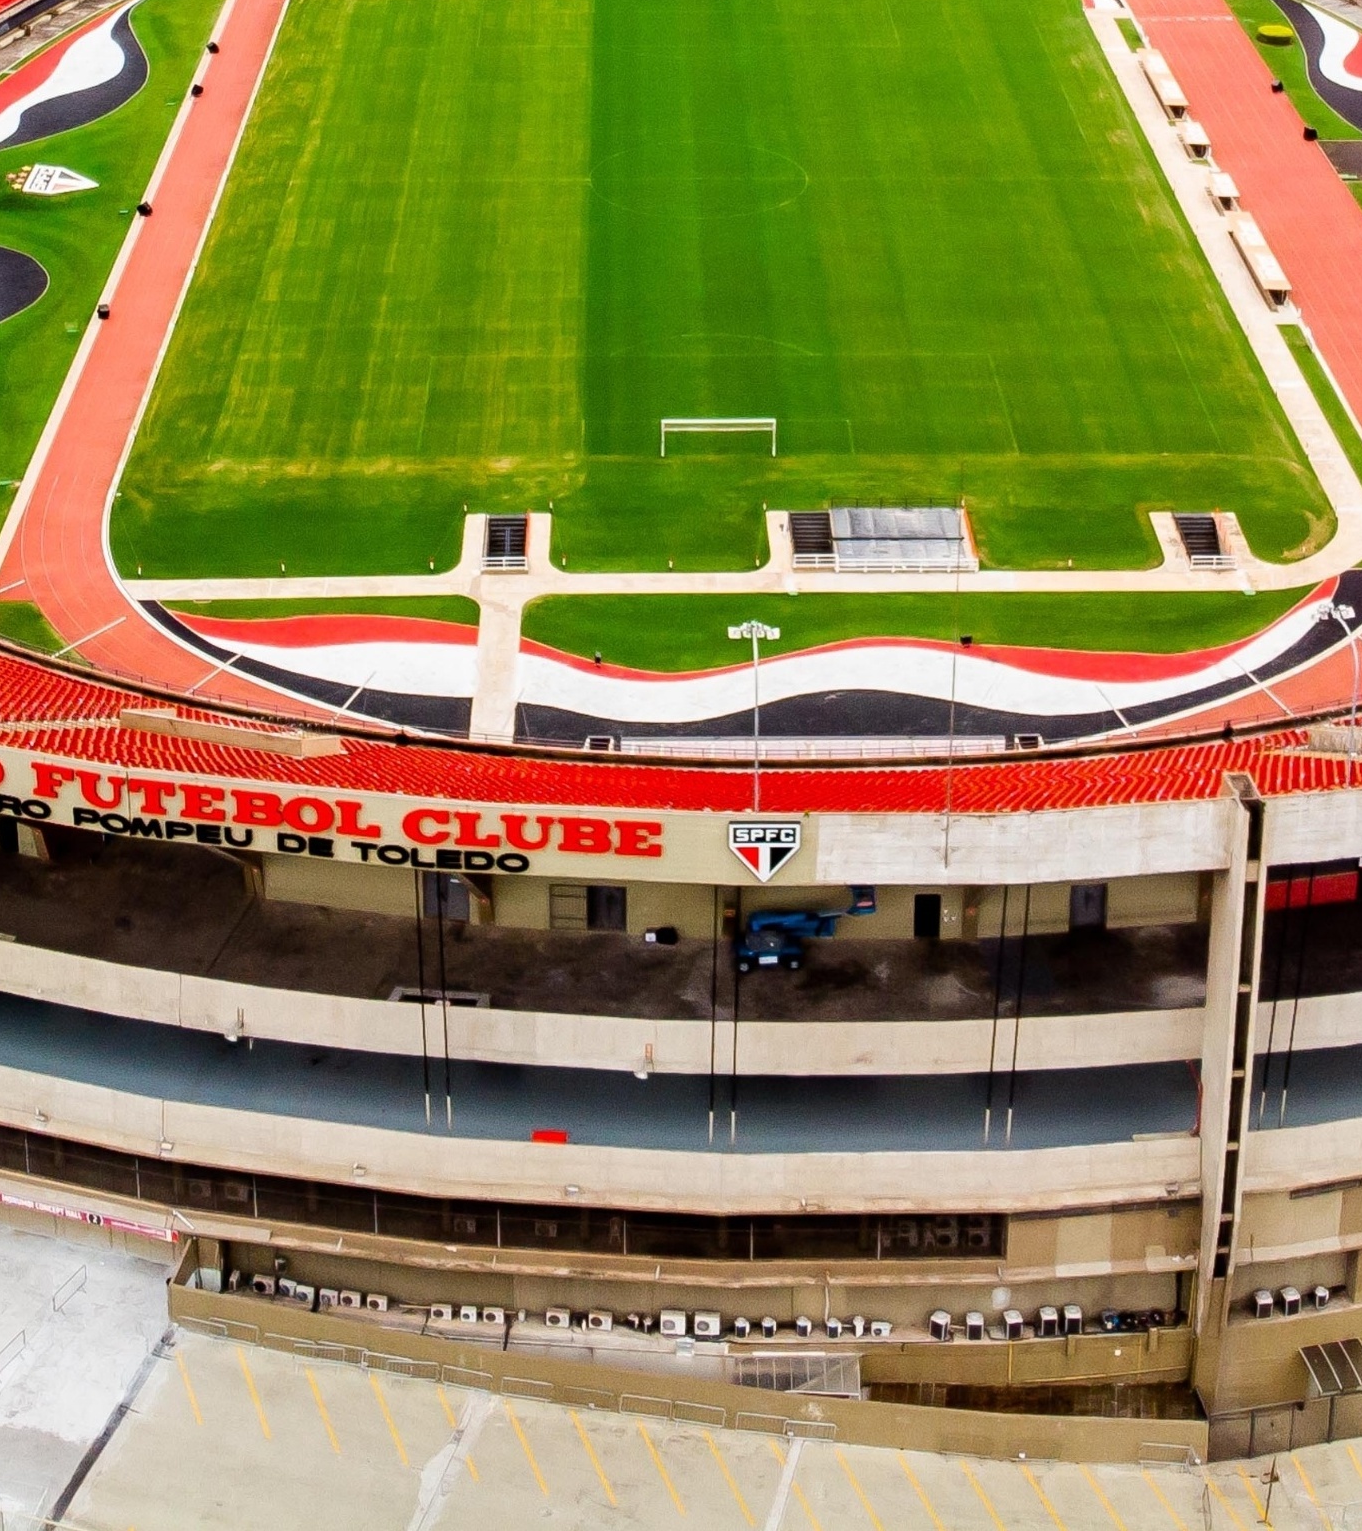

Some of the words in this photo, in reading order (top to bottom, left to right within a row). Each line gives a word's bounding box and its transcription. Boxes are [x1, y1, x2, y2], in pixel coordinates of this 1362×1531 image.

[32, 761, 381, 838] FUTEBOL
[402, 808, 663, 859] CLUBE
[72, 806, 255, 849] POMPEU
[276, 831, 335, 860] DE
[351, 840, 531, 874] TOLEDO
[734, 827, 797, 846] SPFC
